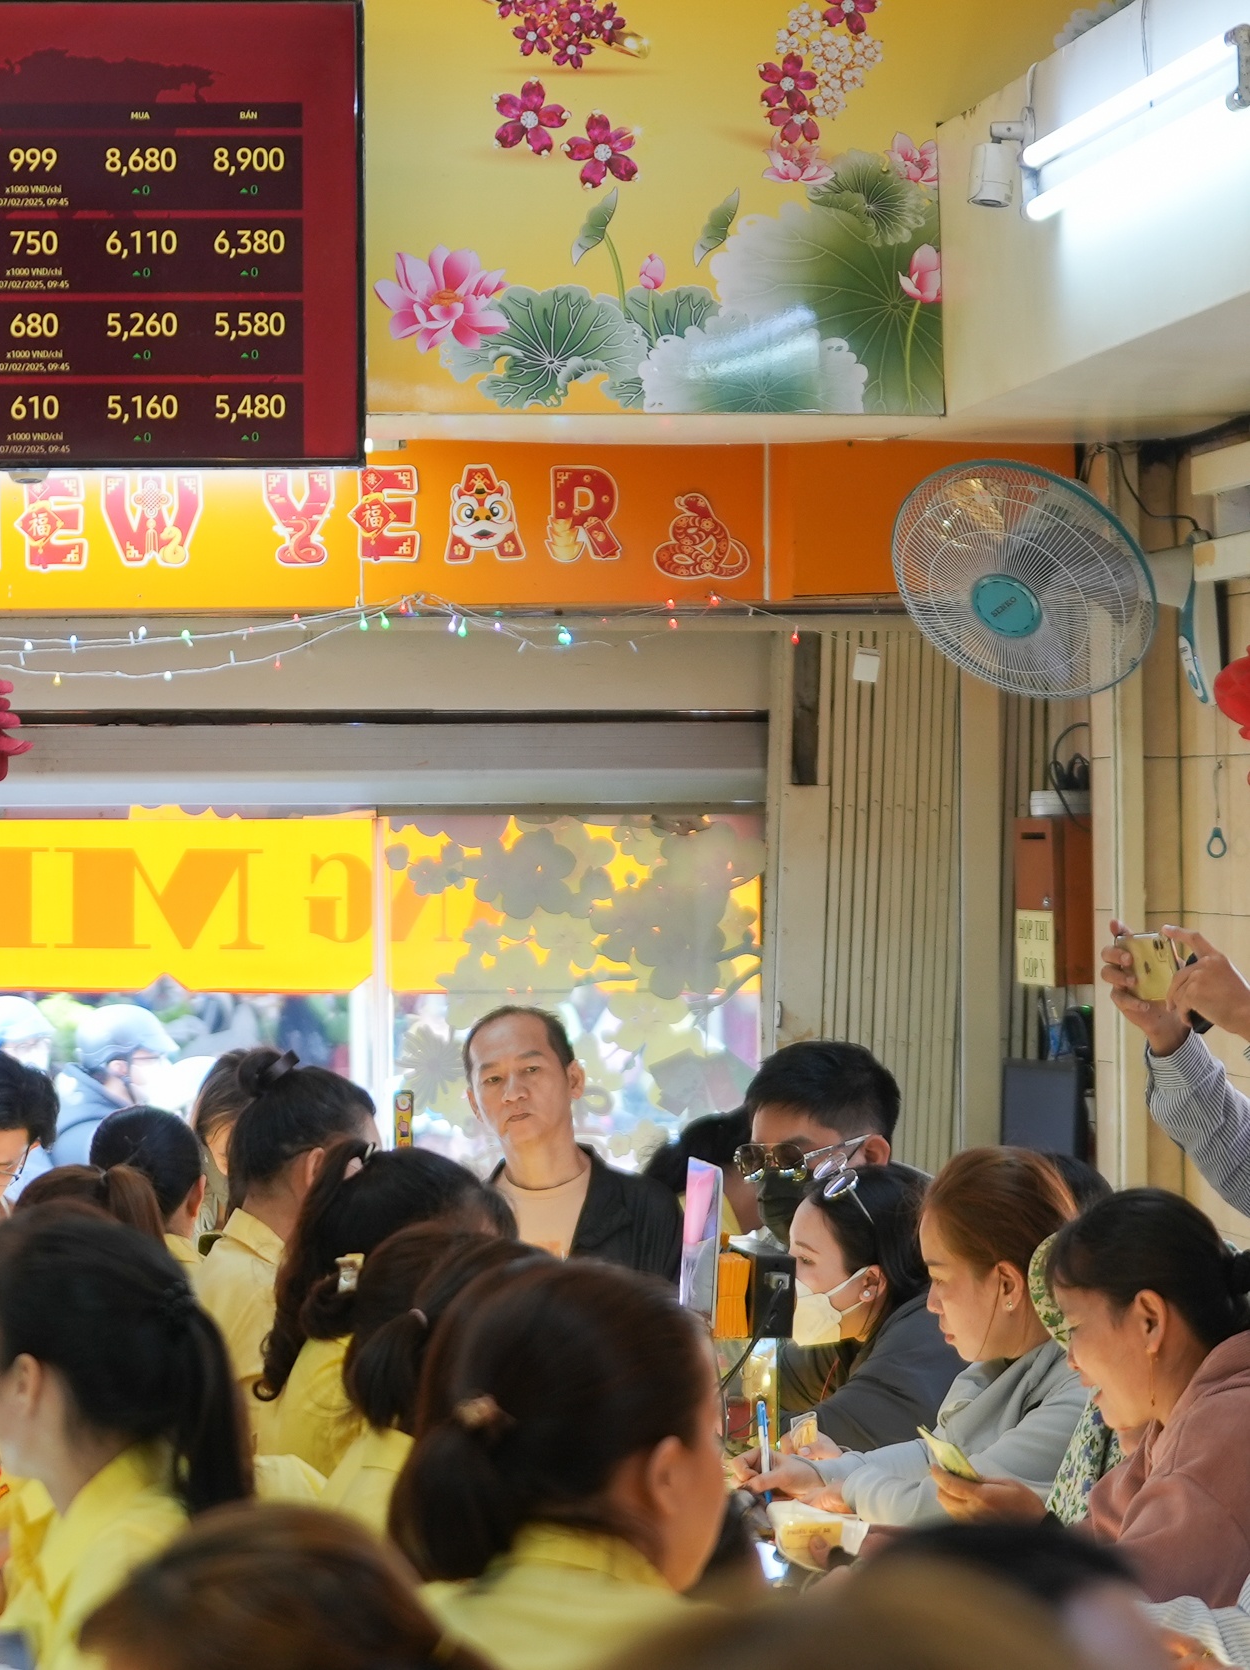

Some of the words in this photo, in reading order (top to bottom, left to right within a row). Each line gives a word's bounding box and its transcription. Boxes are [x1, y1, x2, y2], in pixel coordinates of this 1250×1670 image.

[130, 111, 151, 120] MUA
[239, 109, 258, 120] BÁN
[8, 147, 58, 172] 999
[105, 147, 177, 177] 8,680
[213, 147, 285, 177] 8,900
[5, 185, 29, 194] x1000
[9, 230, 58, 255] 750
[105, 229, 178, 259] 6,110
[213, 229, 285, 259] 6,380
[6, 267, 30, 276] x1000
[10, 312, 59, 338] 680
[106, 312, 178, 342] 5,260
[214, 311, 286, 341] 5,580
[6, 350, 30, 359] x1000
[10, 395, 59, 420] 610
[107, 394, 178, 424] 5,160
[215, 394, 286, 424] 5,480
[7, 432, 31, 441] x1000
[262, 464, 622, 566] YEAR
[361, 503, 384, 528] 福
